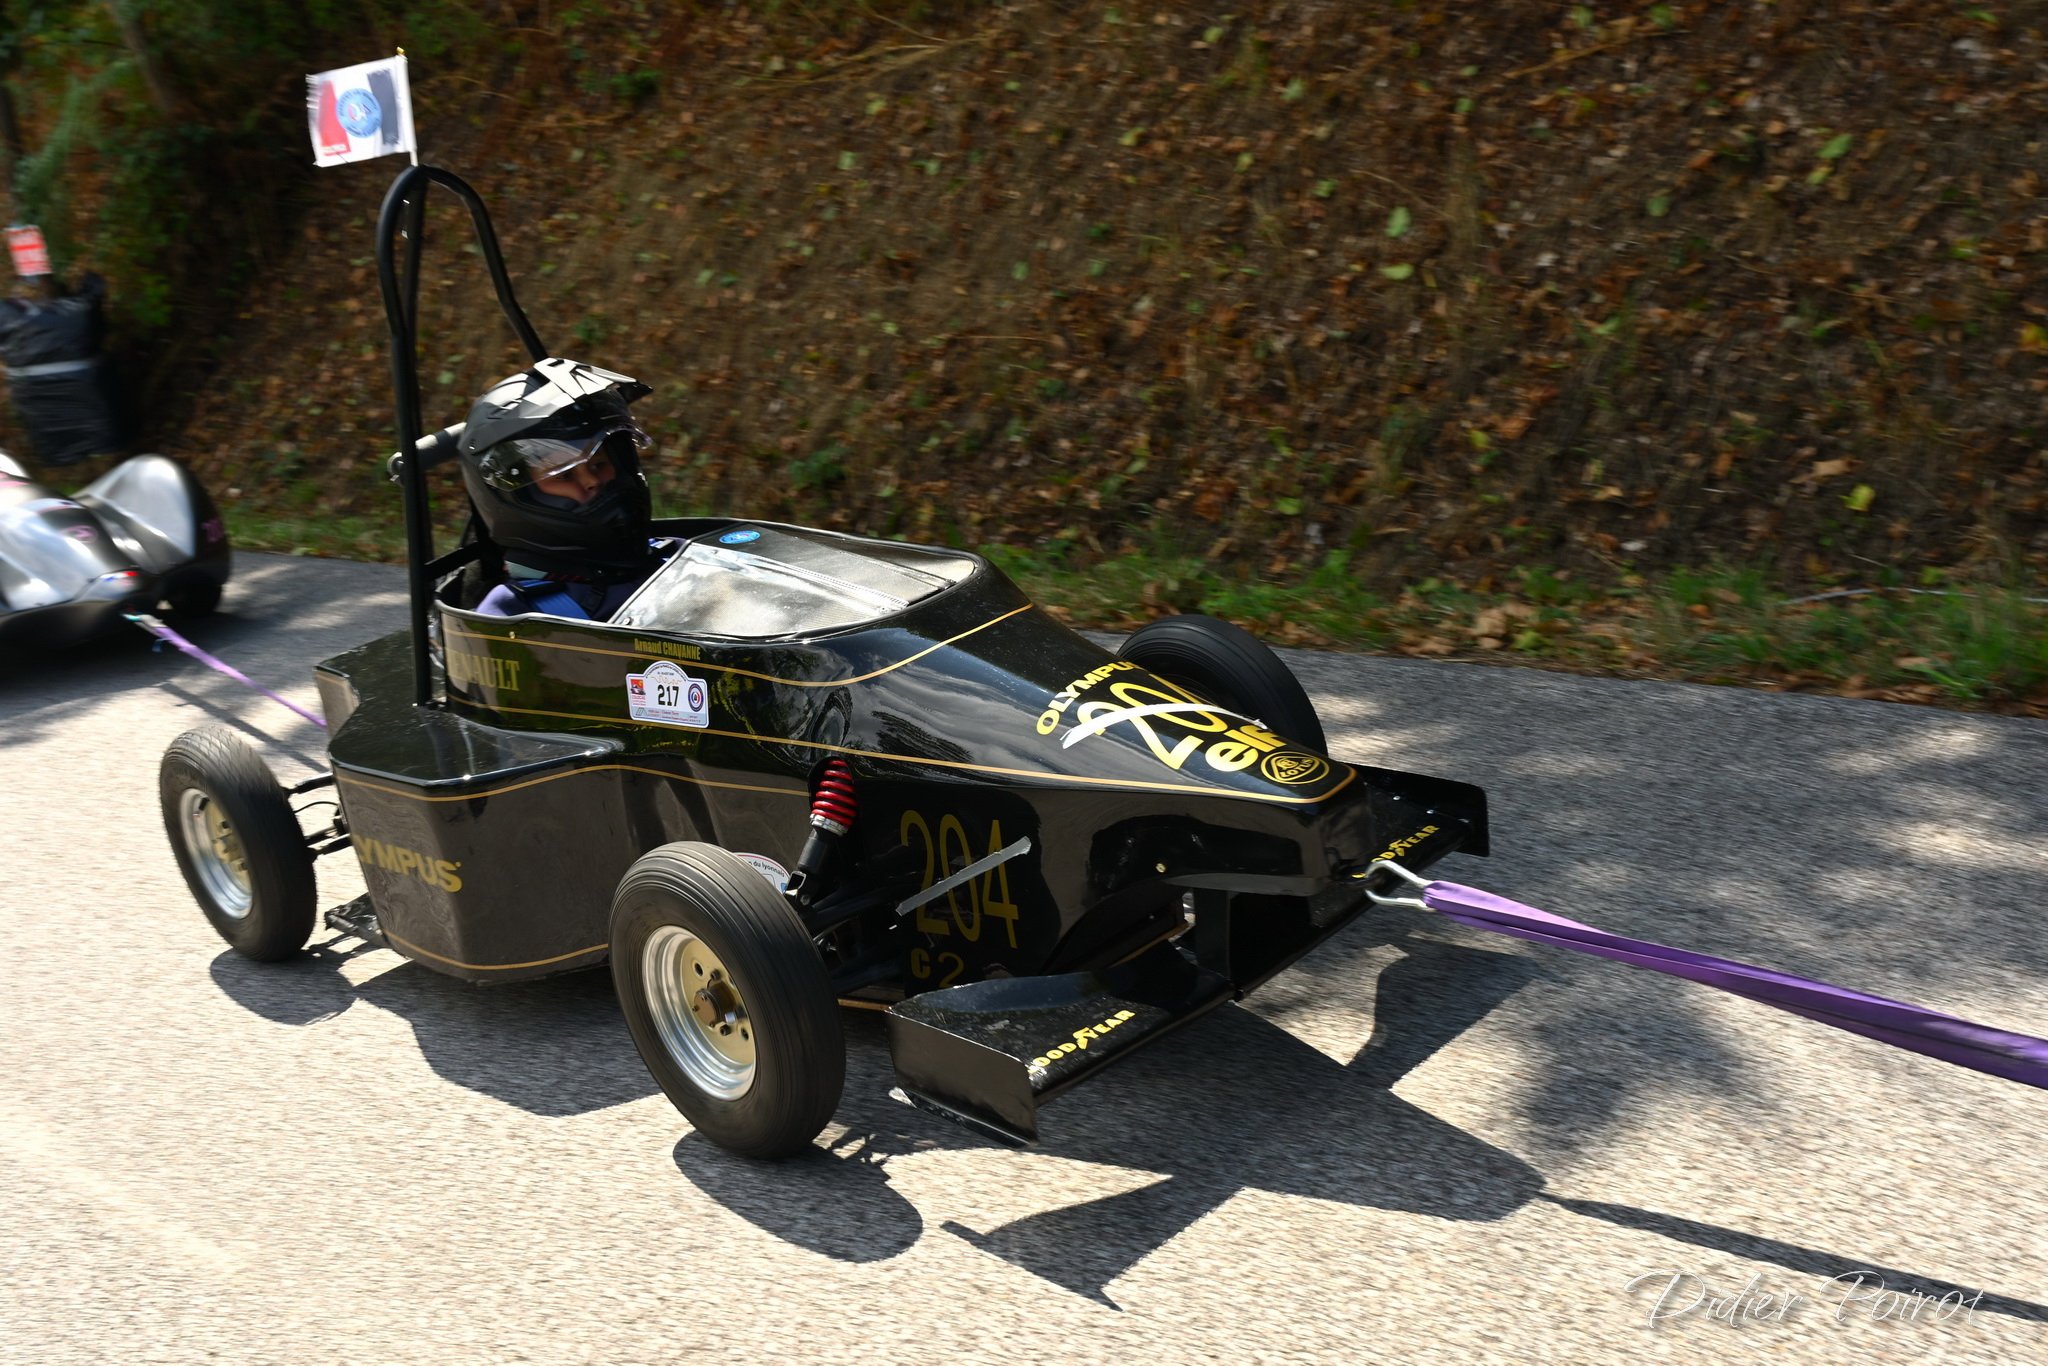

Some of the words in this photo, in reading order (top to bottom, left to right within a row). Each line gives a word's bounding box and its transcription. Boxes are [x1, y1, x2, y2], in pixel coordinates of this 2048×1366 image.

[447, 649, 520, 691] ENAULT
[634, 638, 662, 654] Arnaud
[663, 641, 701, 660] CHAVANNE
[657, 684, 679, 707] 217
[1036, 661, 1148, 736] OLYMPU
[1205, 726, 1287, 772] elf
[1280, 758, 1314, 778] LOTUS
[351, 833, 463, 893] YMPUS
[901, 810, 1020, 949] 204
